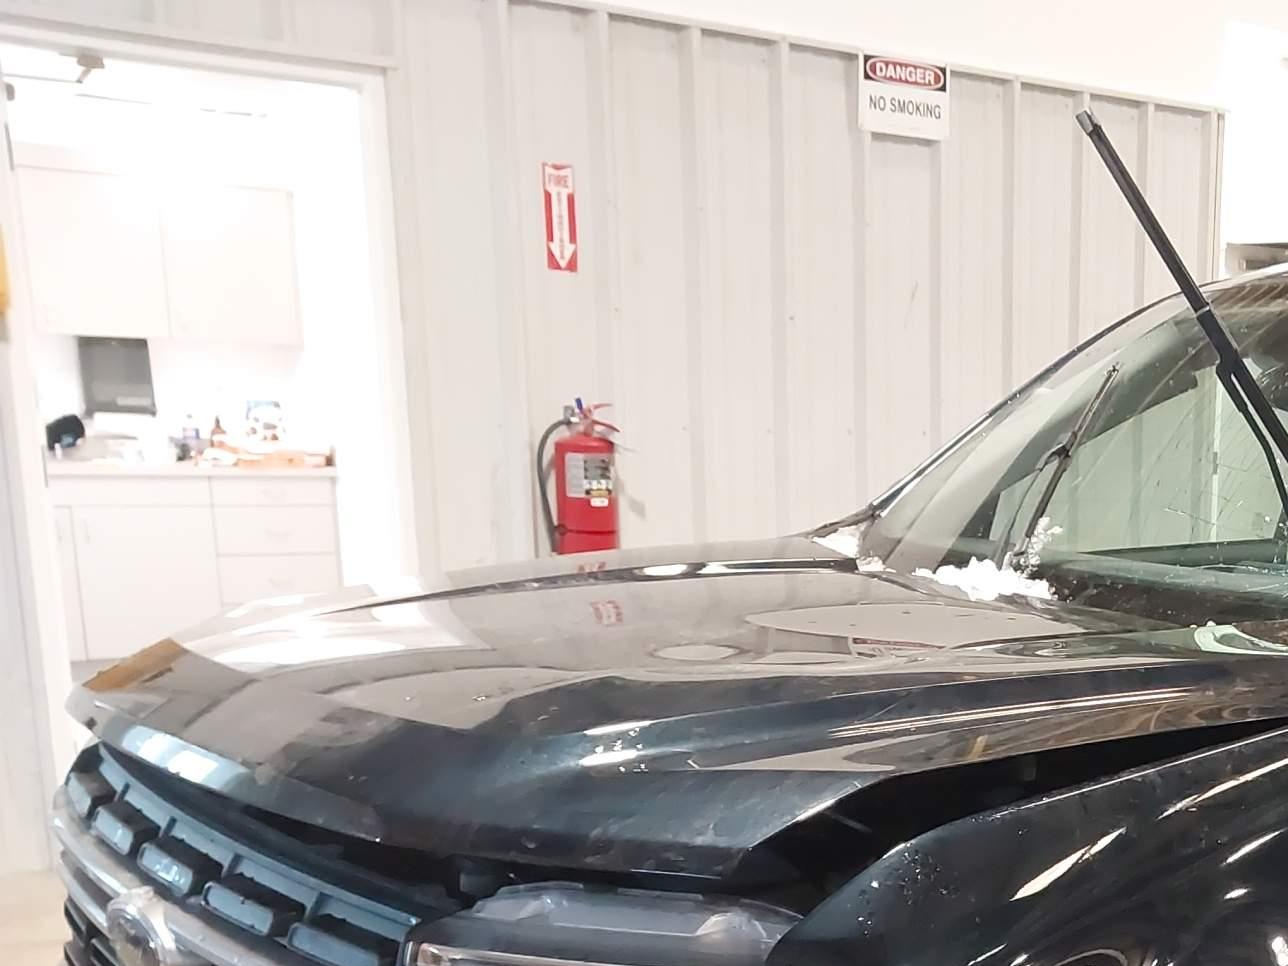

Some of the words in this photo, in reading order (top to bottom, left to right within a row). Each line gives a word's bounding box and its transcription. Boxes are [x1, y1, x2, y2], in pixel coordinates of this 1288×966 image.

[875, 62, 934, 85] DANGER
[869, 94, 886, 111] NO
[890, 97, 941, 119] SMOKING
